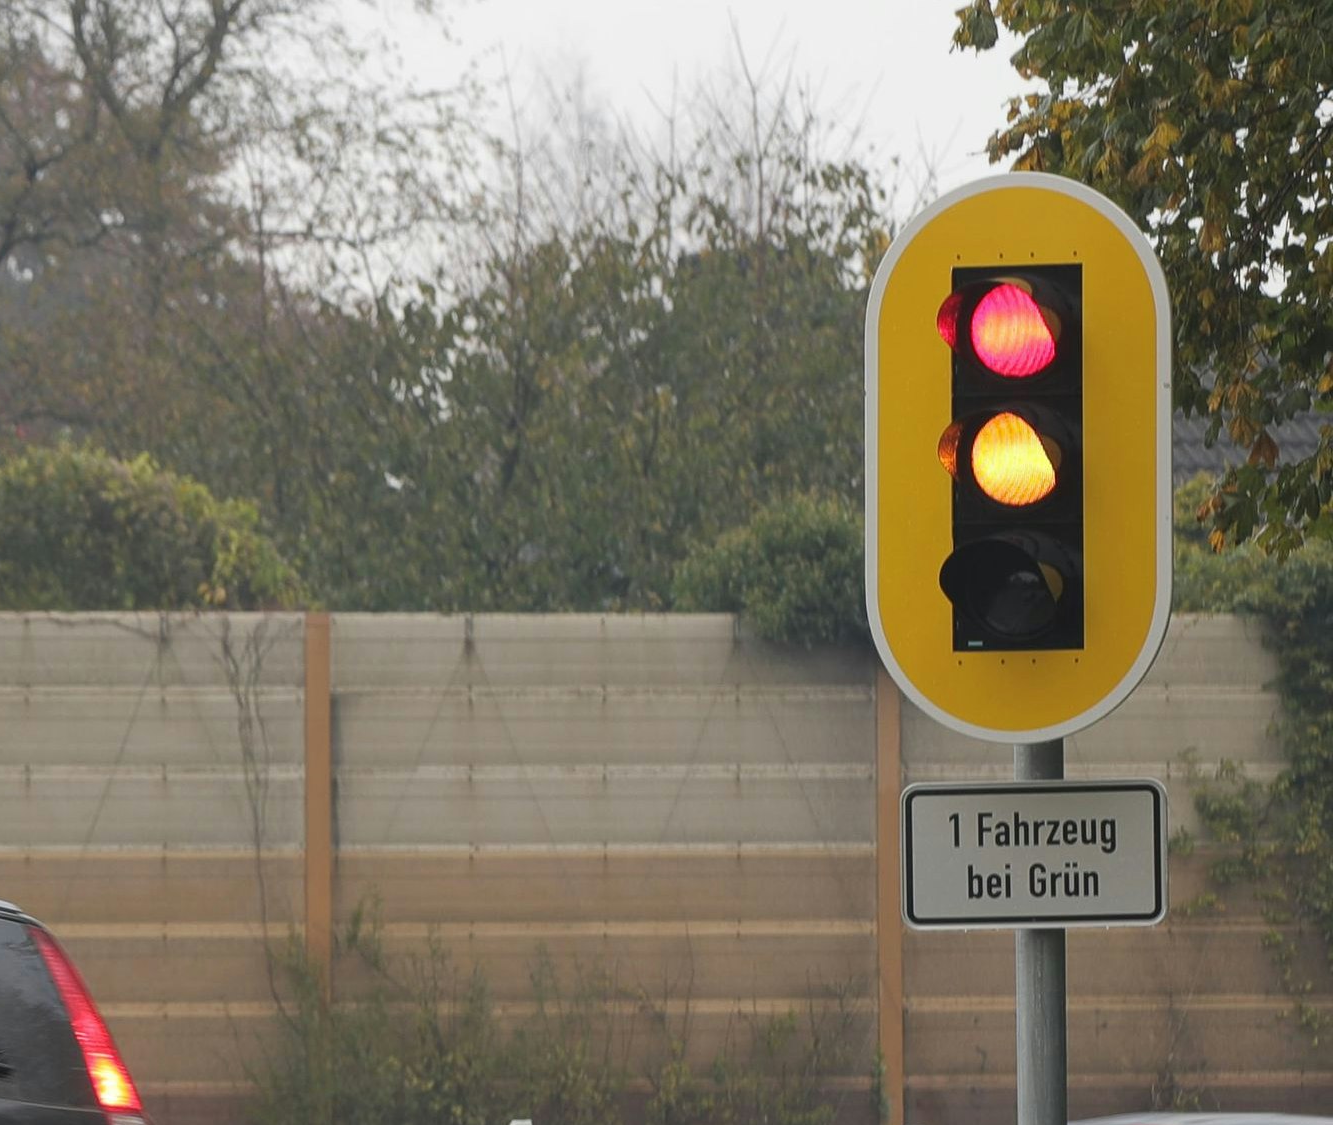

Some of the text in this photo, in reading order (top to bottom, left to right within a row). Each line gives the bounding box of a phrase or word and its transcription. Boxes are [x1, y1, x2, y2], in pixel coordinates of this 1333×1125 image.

[949, 811, 1117, 854] 1 Fahrzeug
[967, 863, 1100, 900] bei Grün
